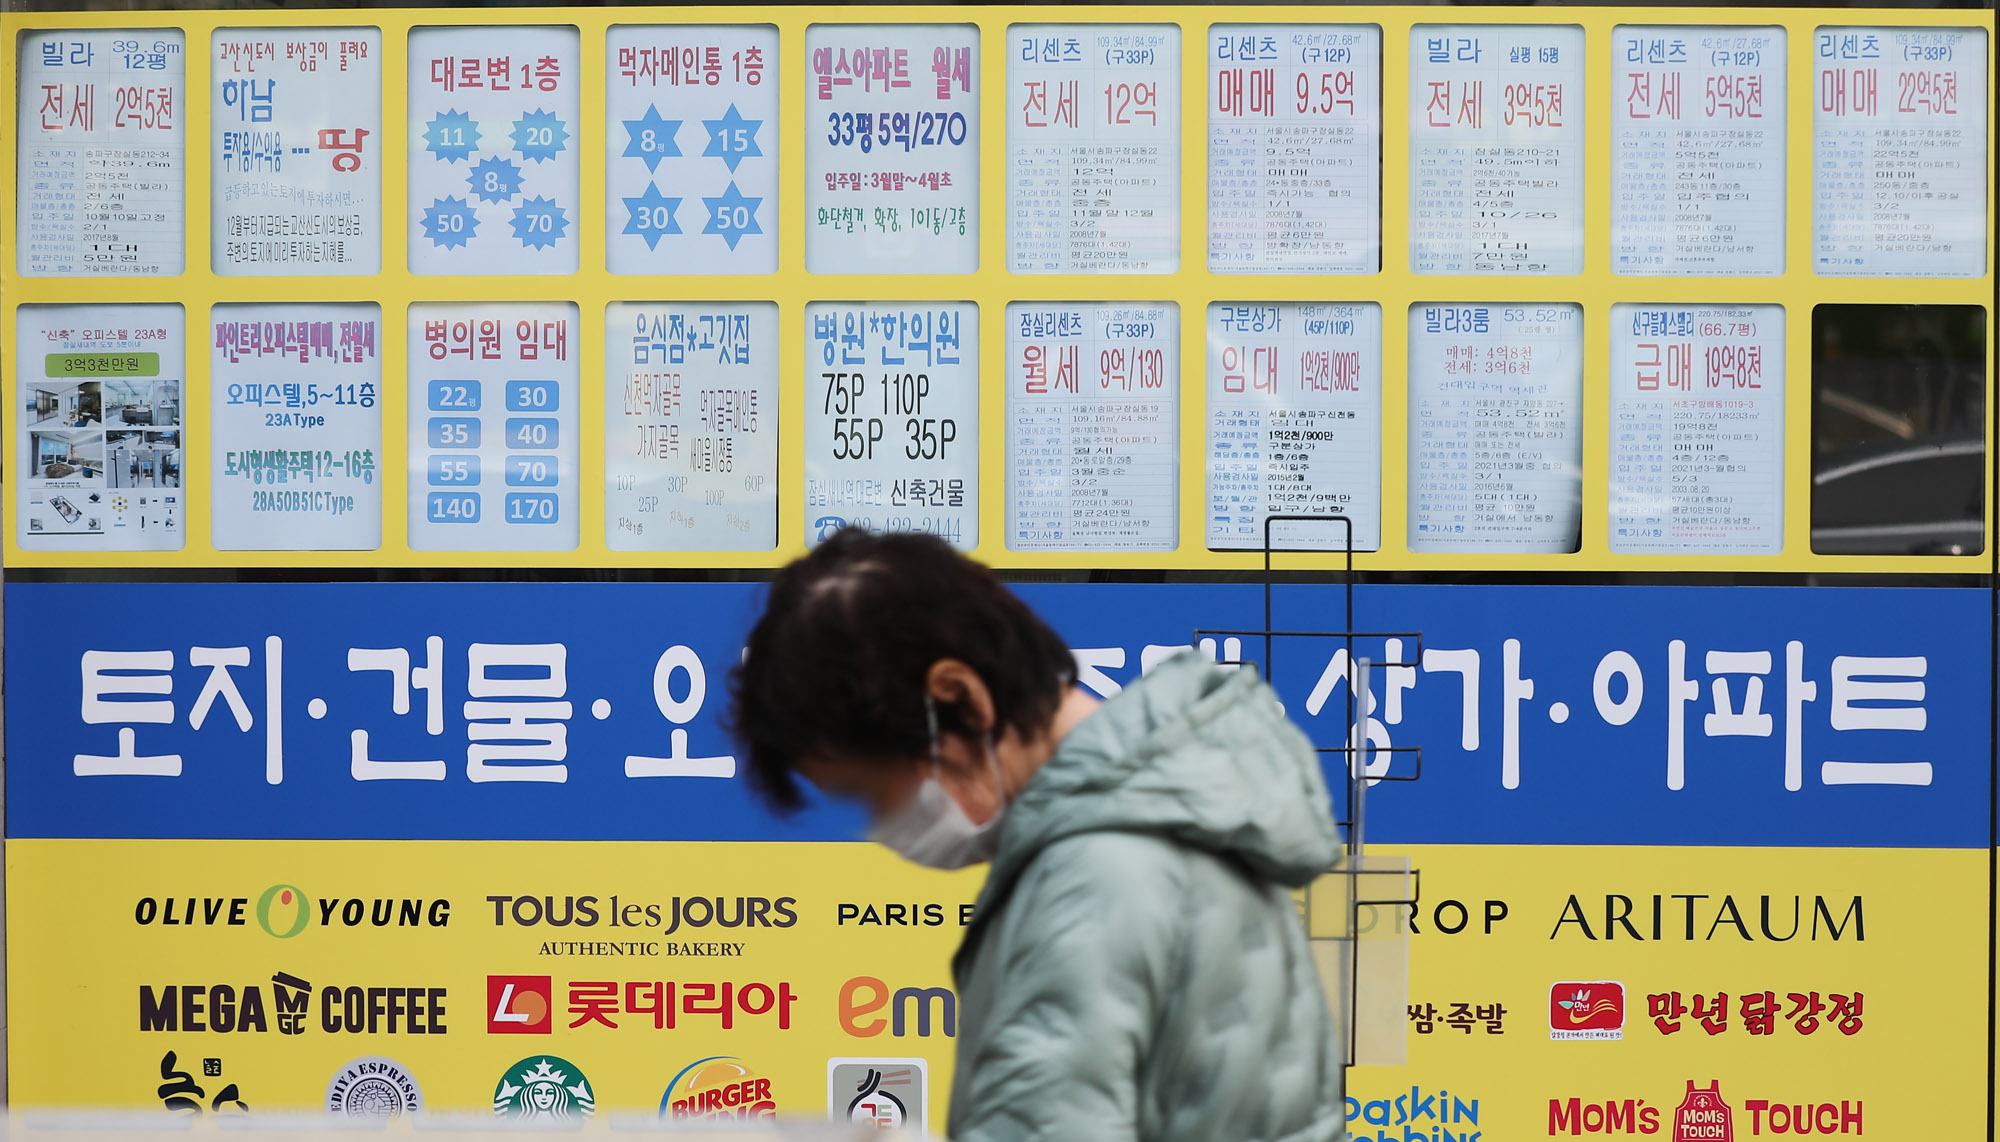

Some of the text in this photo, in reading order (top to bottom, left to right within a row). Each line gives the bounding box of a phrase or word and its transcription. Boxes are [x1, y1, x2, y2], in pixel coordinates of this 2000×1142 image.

[42, 42, 94, 67] 빌라
[287, 42, 327, 71] 보상금이
[340, 42, 368, 71] 풀려요
[1022, 38, 1081, 63] 리센츠
[1218, 36, 1277, 61] 리센츠
[1428, 38, 1482, 64] 빌라
[1510, 47, 1558, 64] 실평 15평
[1627, 39, 1687, 64] 리센츠
[1820, 34, 1880, 59] 리센츠
[124, 54, 166, 70] 12평
[432, 56, 560, 92] 대로변 1층
[619, 46, 764, 86] 먹자메인통 1층
[813, 47, 971, 100] 엘스아파트 월세
[223, 79, 275, 122] 하남
[1105, 82, 1156, 126] 12억
[1297, 71, 1353, 115] 9.5억
[1504, 83, 1562, 128] 3억5천
[1706, 75, 1762, 119] 5억5천
[1898, 71, 1957, 115] 22억5천
[115, 87, 172, 130] 2억5천
[440, 128, 553, 146] 11 20
[718, 129, 748, 152] 15
[828, 112, 872, 153] 33평
[318, 128, 370, 172] 땅
[438, 214, 553, 233] 50 70
[637, 207, 748, 229] 30 50
[1021, 312, 1082, 337] 잠실리센츠
[1221, 307, 1281, 332] 구분상가
[1304, 319, 1353, 335] (45P/110P)
[1426, 308, 1489, 333] 빌라3룸
[1699, 323, 1757, 337] (66.7평)
[82, 329, 128, 341] 오피스텔
[135, 329, 167, 340] 23A형
[340, 321, 374, 363] 전월세
[426, 320, 566, 361] 병의원 임대
[65, 358, 139, 372] 3억3천만원
[1487, 346, 1532, 360] 4억8천
[1101, 347, 1163, 392] 9억/130
[1301, 350, 1360, 393] 1억2천/900만
[1485, 361, 1531, 374] 3억6천
[1635, 343, 1691, 391] 급매
[1705, 345, 1761, 390] 19억8천
[518, 386, 546, 407] 30
[624, 373, 680, 416] 신천먹자골목
[822, 373, 929, 415] 75P 110P
[440, 424, 546, 445] 35 40
[833, 418, 956, 460] 55P 35P
[1269, 431, 1334, 440] 1억2천/900만
[440, 462, 546, 481] 55 70
[617, 475, 763, 493] 10P 30P 60P
[638, 490, 724, 513] 25P 100P
[891, 479, 964, 507] 신축건물
[433, 499, 553, 519] 140 170
[135, 897, 450, 928] OLIVE YOUNG
[486, 895, 798, 936] TOUS les JOURS
[838, 904, 944, 926] PARIS
[1549, 894, 1865, 941] ARITAUM
[538, 942, 745, 957] AUTHENTIC BAKERY
[139, 984, 267, 1032] MEGA
[321, 986, 447, 1035] COFFEE
[568, 981, 798, 1031] 롯데리아
[1647, 991, 1864, 1036] 만년 닭강정
[1681, 1124, 1724, 1138] TOUCH
[1745, 1100, 1863, 1135] TOUCH
